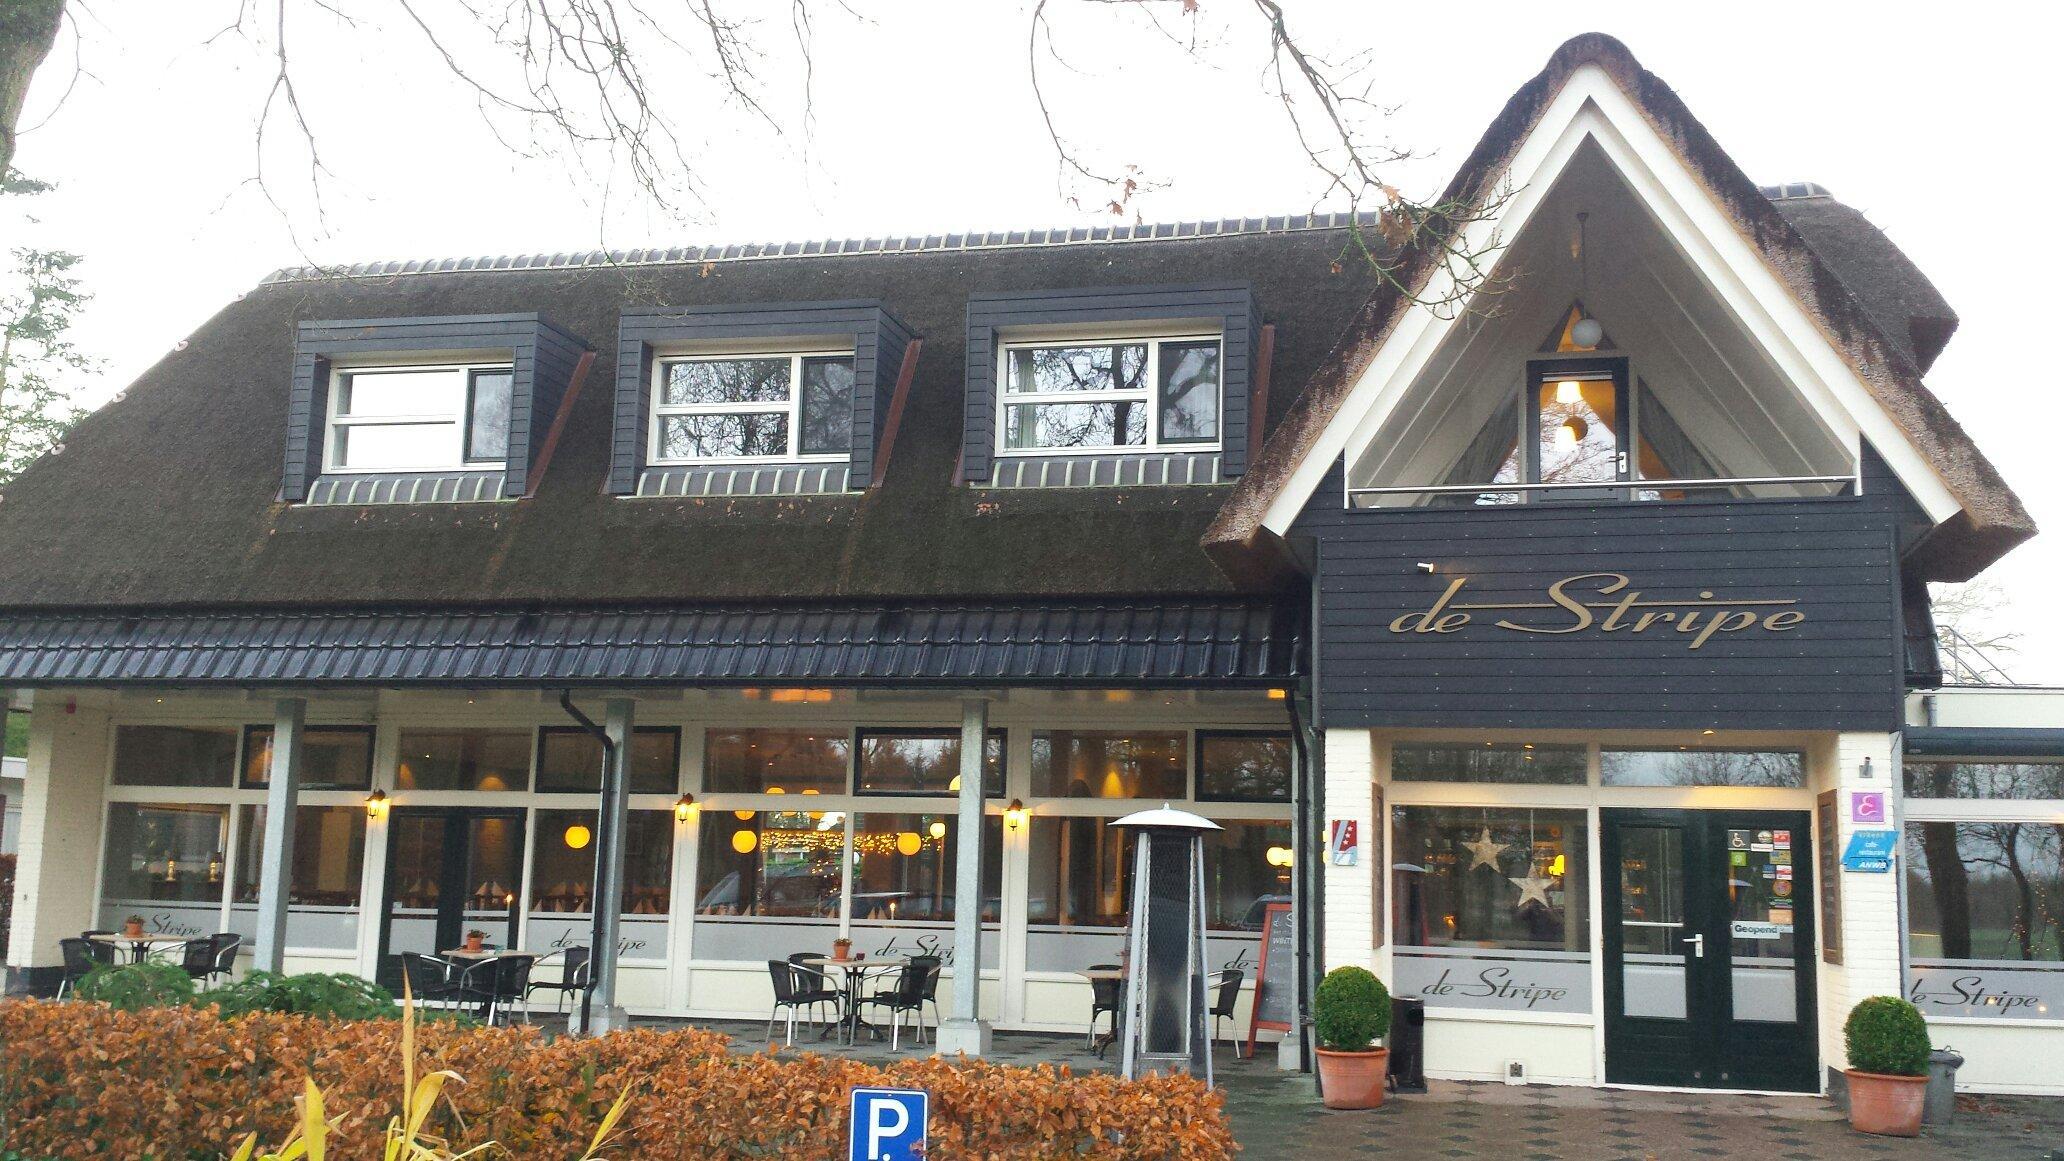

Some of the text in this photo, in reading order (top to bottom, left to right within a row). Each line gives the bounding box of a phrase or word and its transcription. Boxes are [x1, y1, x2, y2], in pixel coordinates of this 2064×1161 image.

[1389, 572, 1805, 649] de Stripe
[550, 928, 647, 956] de ipe
[1734, 924, 1778, 934] Geopend
[875, 934, 954, 965] de Stri
[1224, 948, 1248, 970] de
[1422, 967, 1567, 1008] de Stripe
[1933, 976, 2040, 1015] Stripe
[868, 1098, 909, 1160] P
